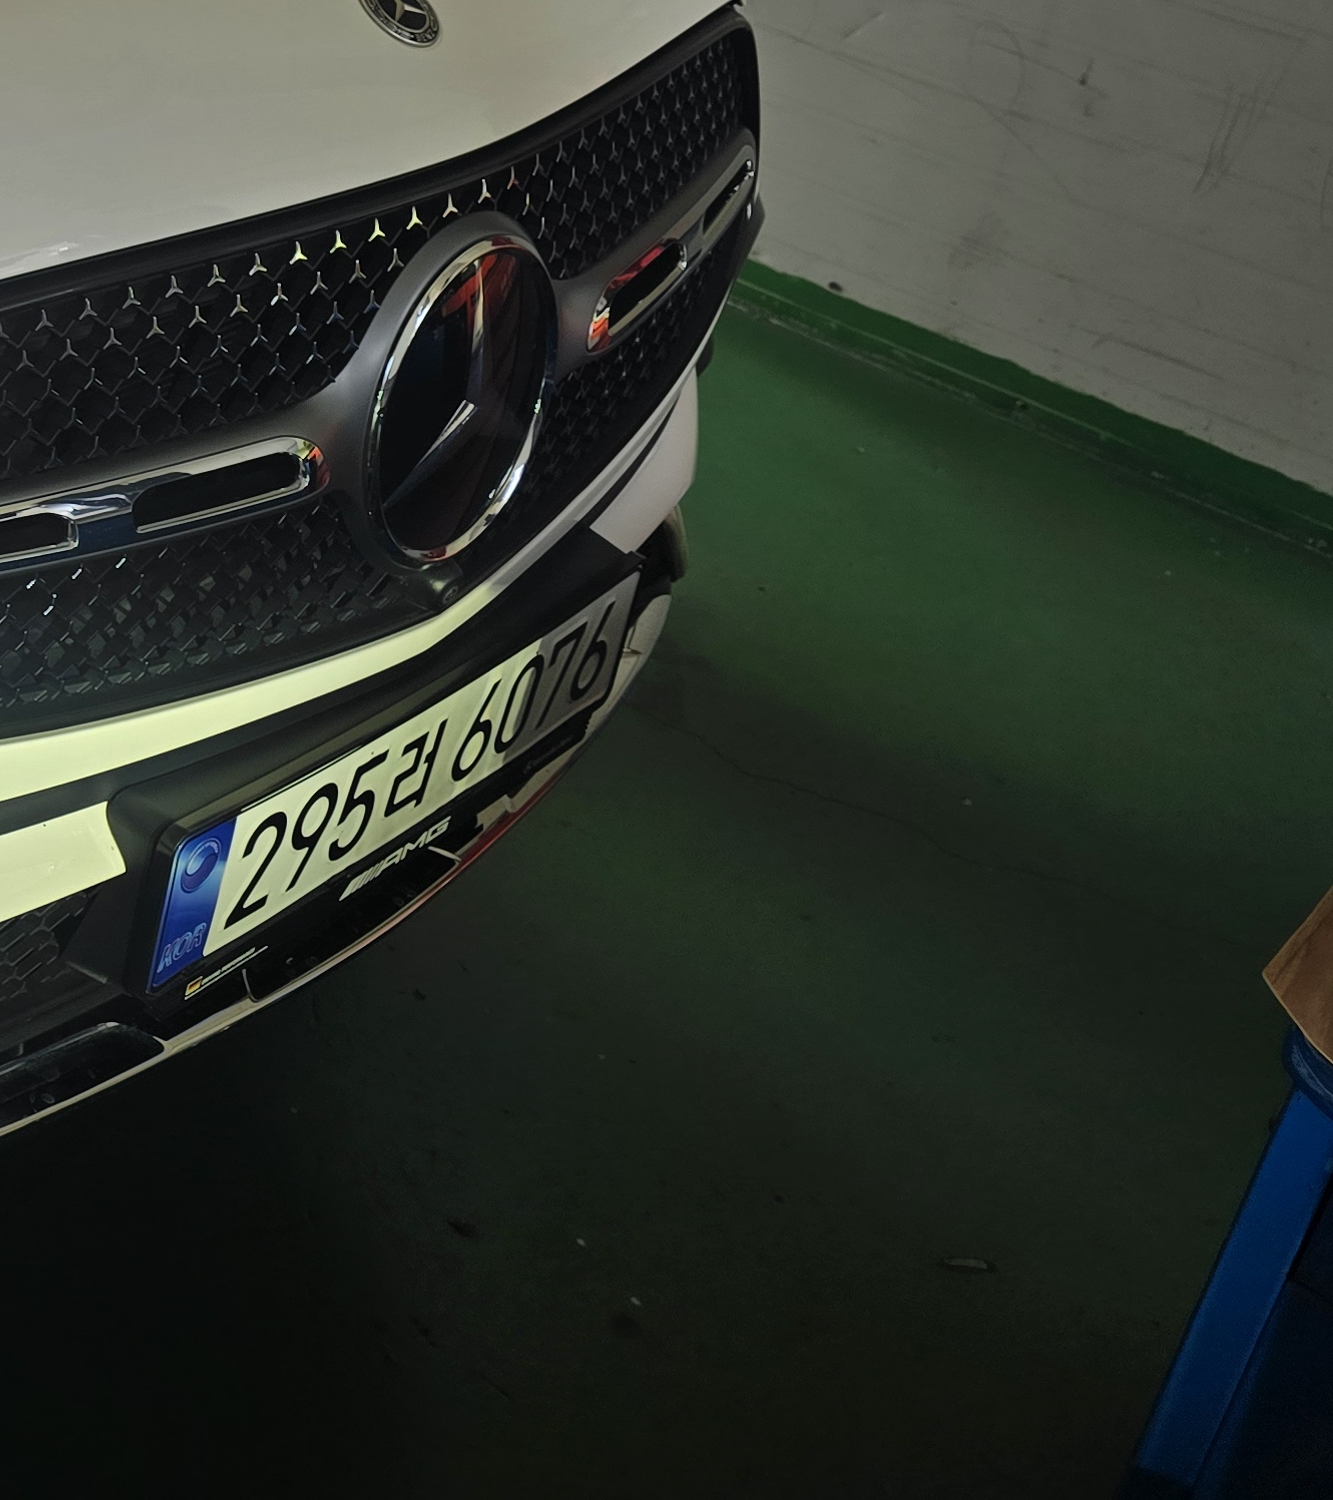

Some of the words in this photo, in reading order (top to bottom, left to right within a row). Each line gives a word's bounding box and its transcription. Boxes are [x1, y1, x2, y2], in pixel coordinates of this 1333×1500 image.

[223, 717, 449, 931] 295러
[450, 599, 618, 782] 6076
[156, 921, 208, 974] KOR
